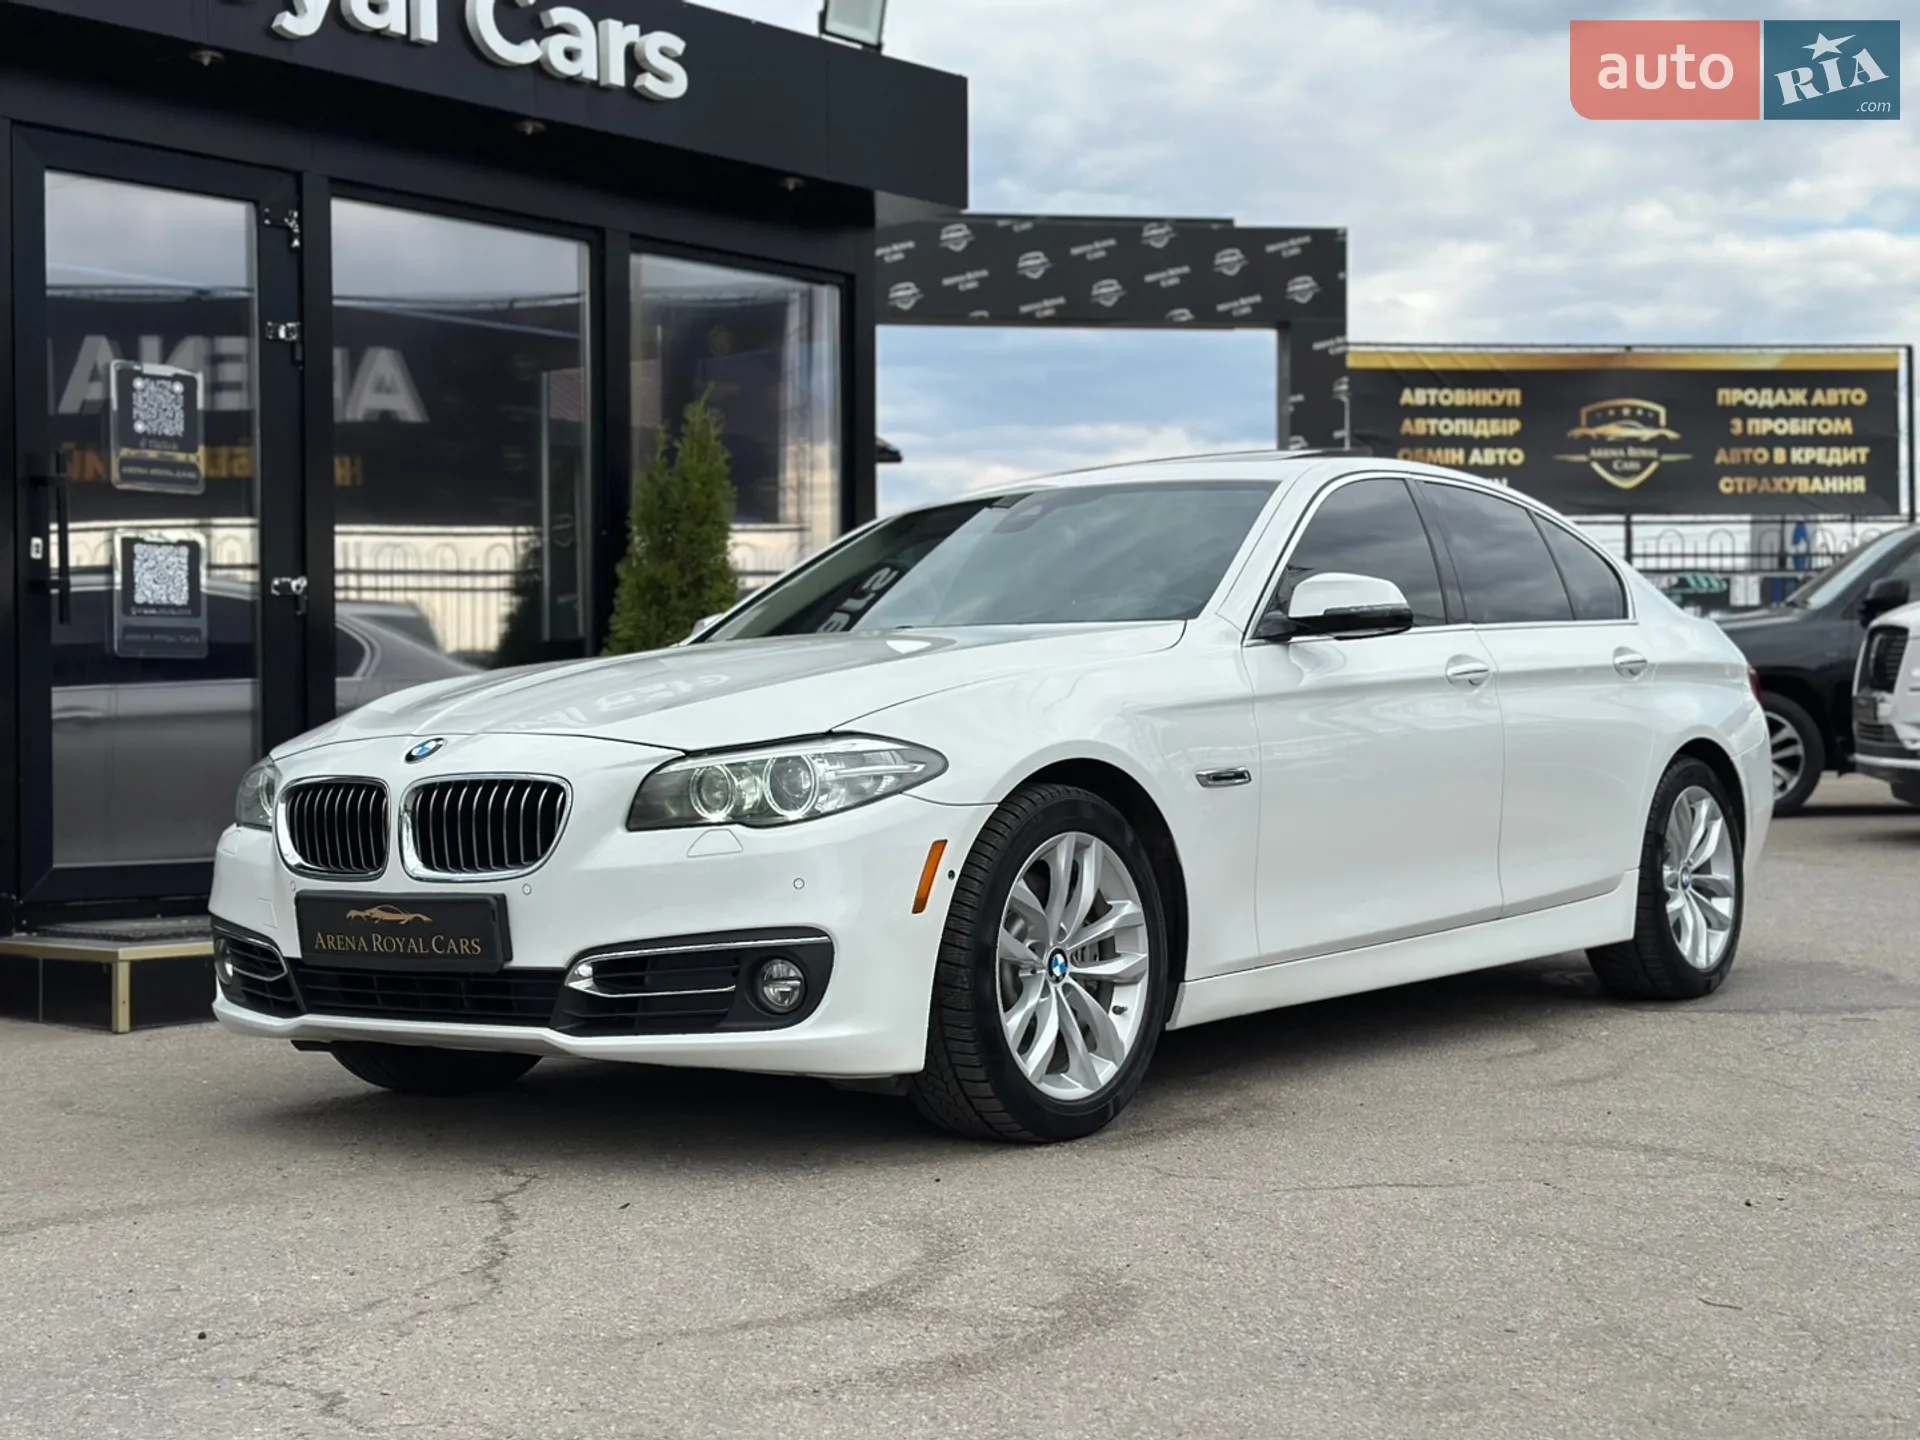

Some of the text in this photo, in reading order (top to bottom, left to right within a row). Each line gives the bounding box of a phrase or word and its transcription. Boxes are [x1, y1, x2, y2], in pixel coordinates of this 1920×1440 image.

[465, 0, 688, 100] Cars
[1399, 387, 1522, 406] АВТОВИКУП
[1716, 387, 1868, 408] ПРОДАЖ АВТО
[1400, 417, 1522, 438] АВТОПІДБІР
[1746, 417, 1854, 435] ПРОБІГОМ
[1468, 447, 1525, 465] АВТО
[1714, 447, 1870, 466] АВТО В КРЕДИТ
[1718, 476, 1866, 494] СТРАХУВАННЯ
[314, 931, 482, 955] ARENA ROYAL CARS
